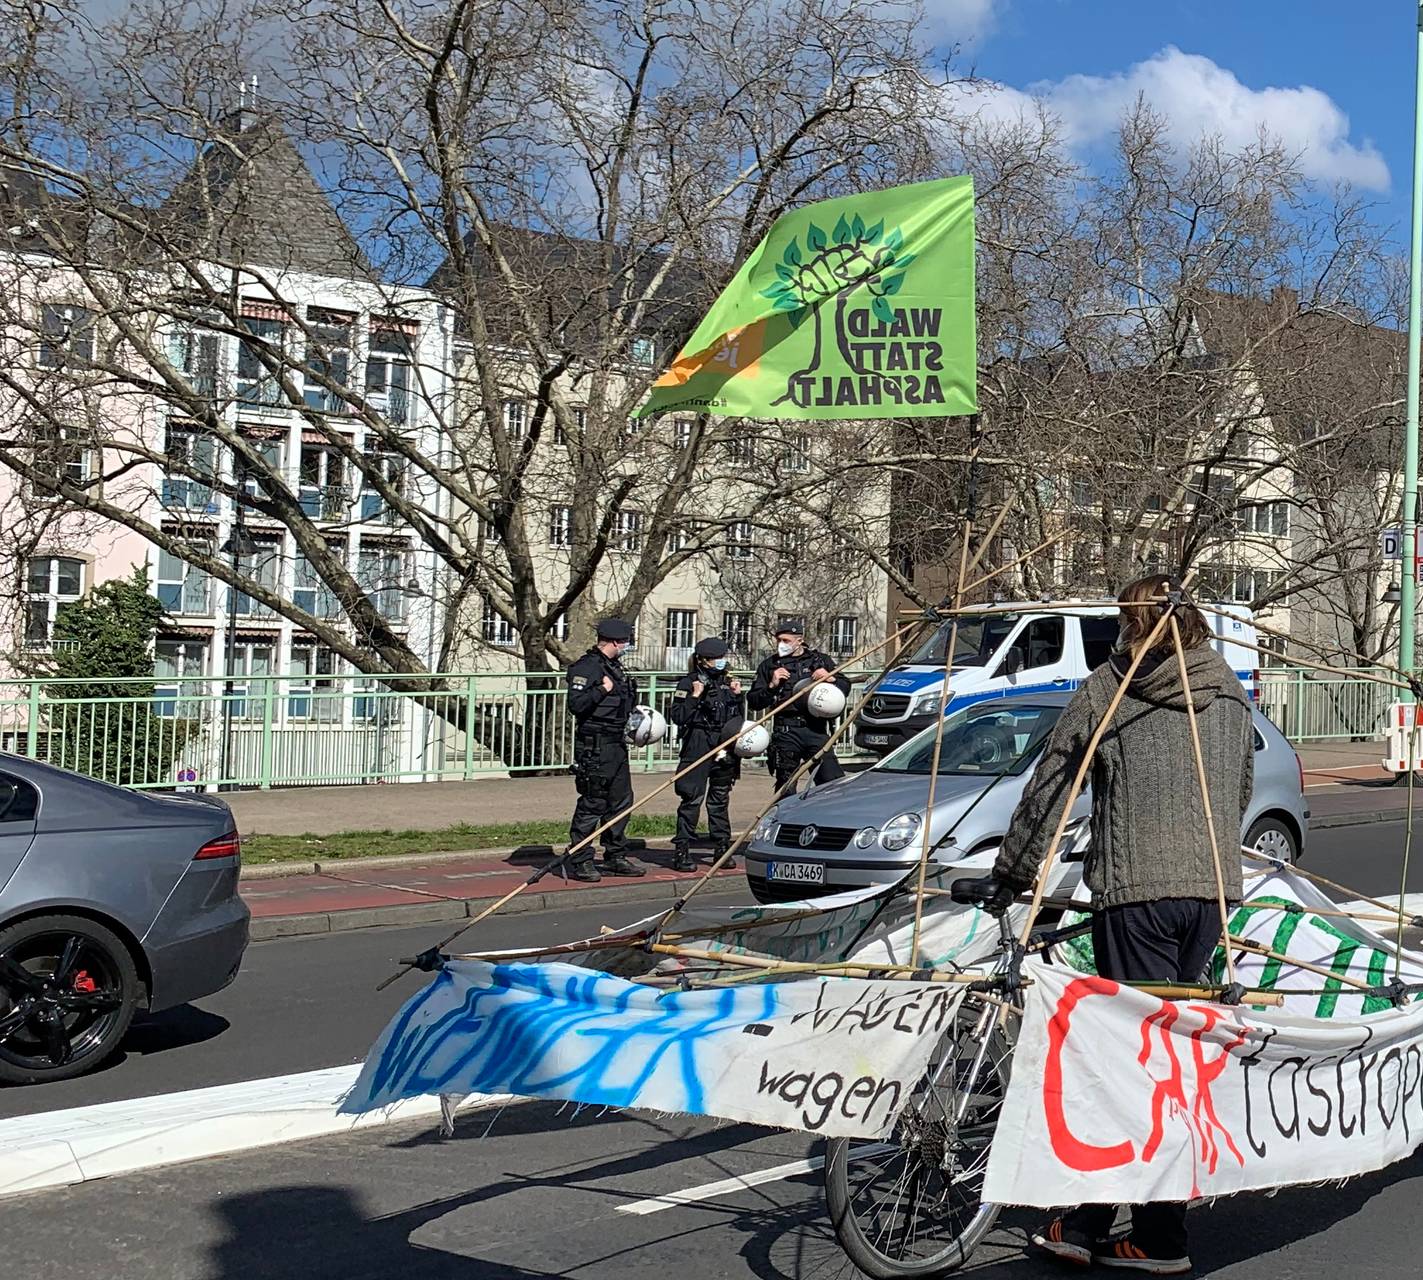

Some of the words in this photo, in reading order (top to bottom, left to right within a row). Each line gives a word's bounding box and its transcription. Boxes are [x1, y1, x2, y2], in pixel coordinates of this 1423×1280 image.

[1385, 538, 1397, 554] D
[797, 865, 823, 881] 3469
[757, 1059, 902, 1130] wagen
